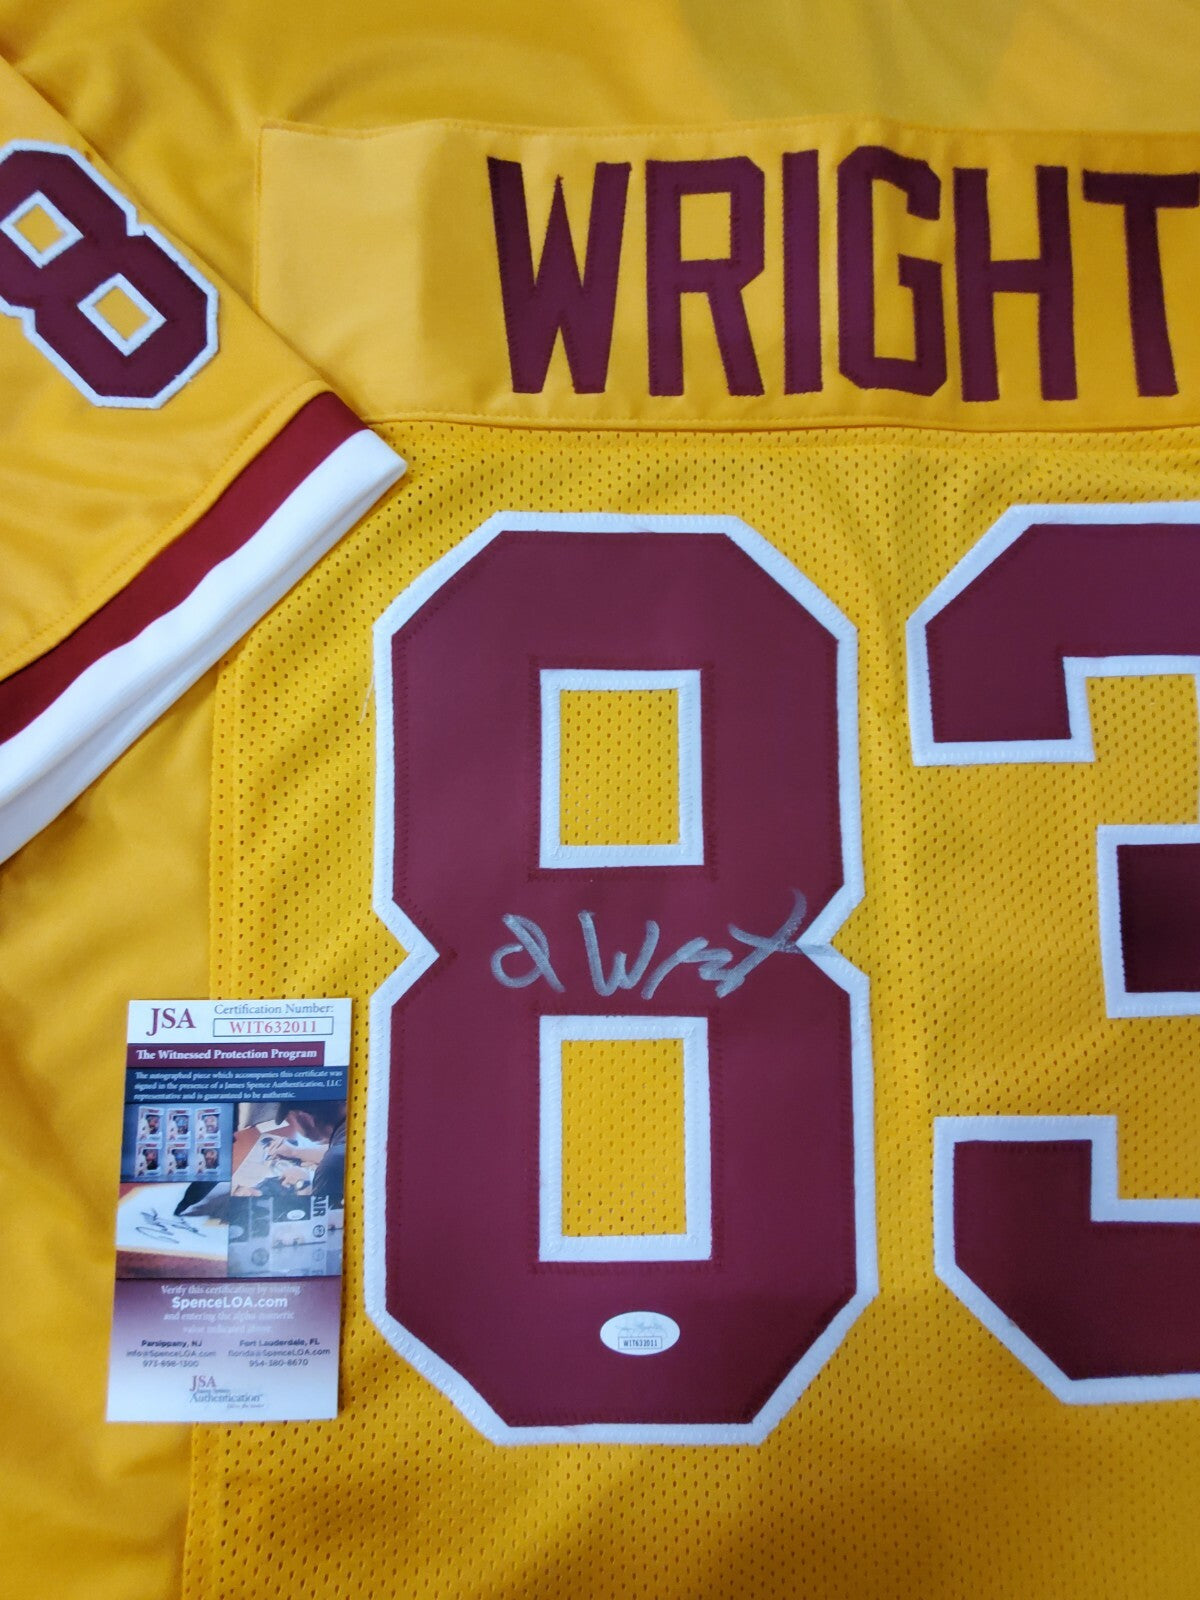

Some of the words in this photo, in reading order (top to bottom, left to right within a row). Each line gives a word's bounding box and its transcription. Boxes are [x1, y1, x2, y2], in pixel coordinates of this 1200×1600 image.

[0, 139, 219, 410] 8
[486, 145, 1200, 403] WRIGHT
[214, 1004, 284, 1015] Certification
[285, 1002, 334, 1014] Number:
[145, 1007, 196, 1037] JSA
[229, 1020, 317, 1034] WIT632011
[136, 1049, 156, 1060] The
[158, 1049, 211, 1060] Witnessed
[213, 1048, 269, 1060] Protection
[271, 1048, 317, 1061] Program
[171, 1296, 288, 1311] SpenceLOA.com
[189, 1376, 216, 1392] JSA
